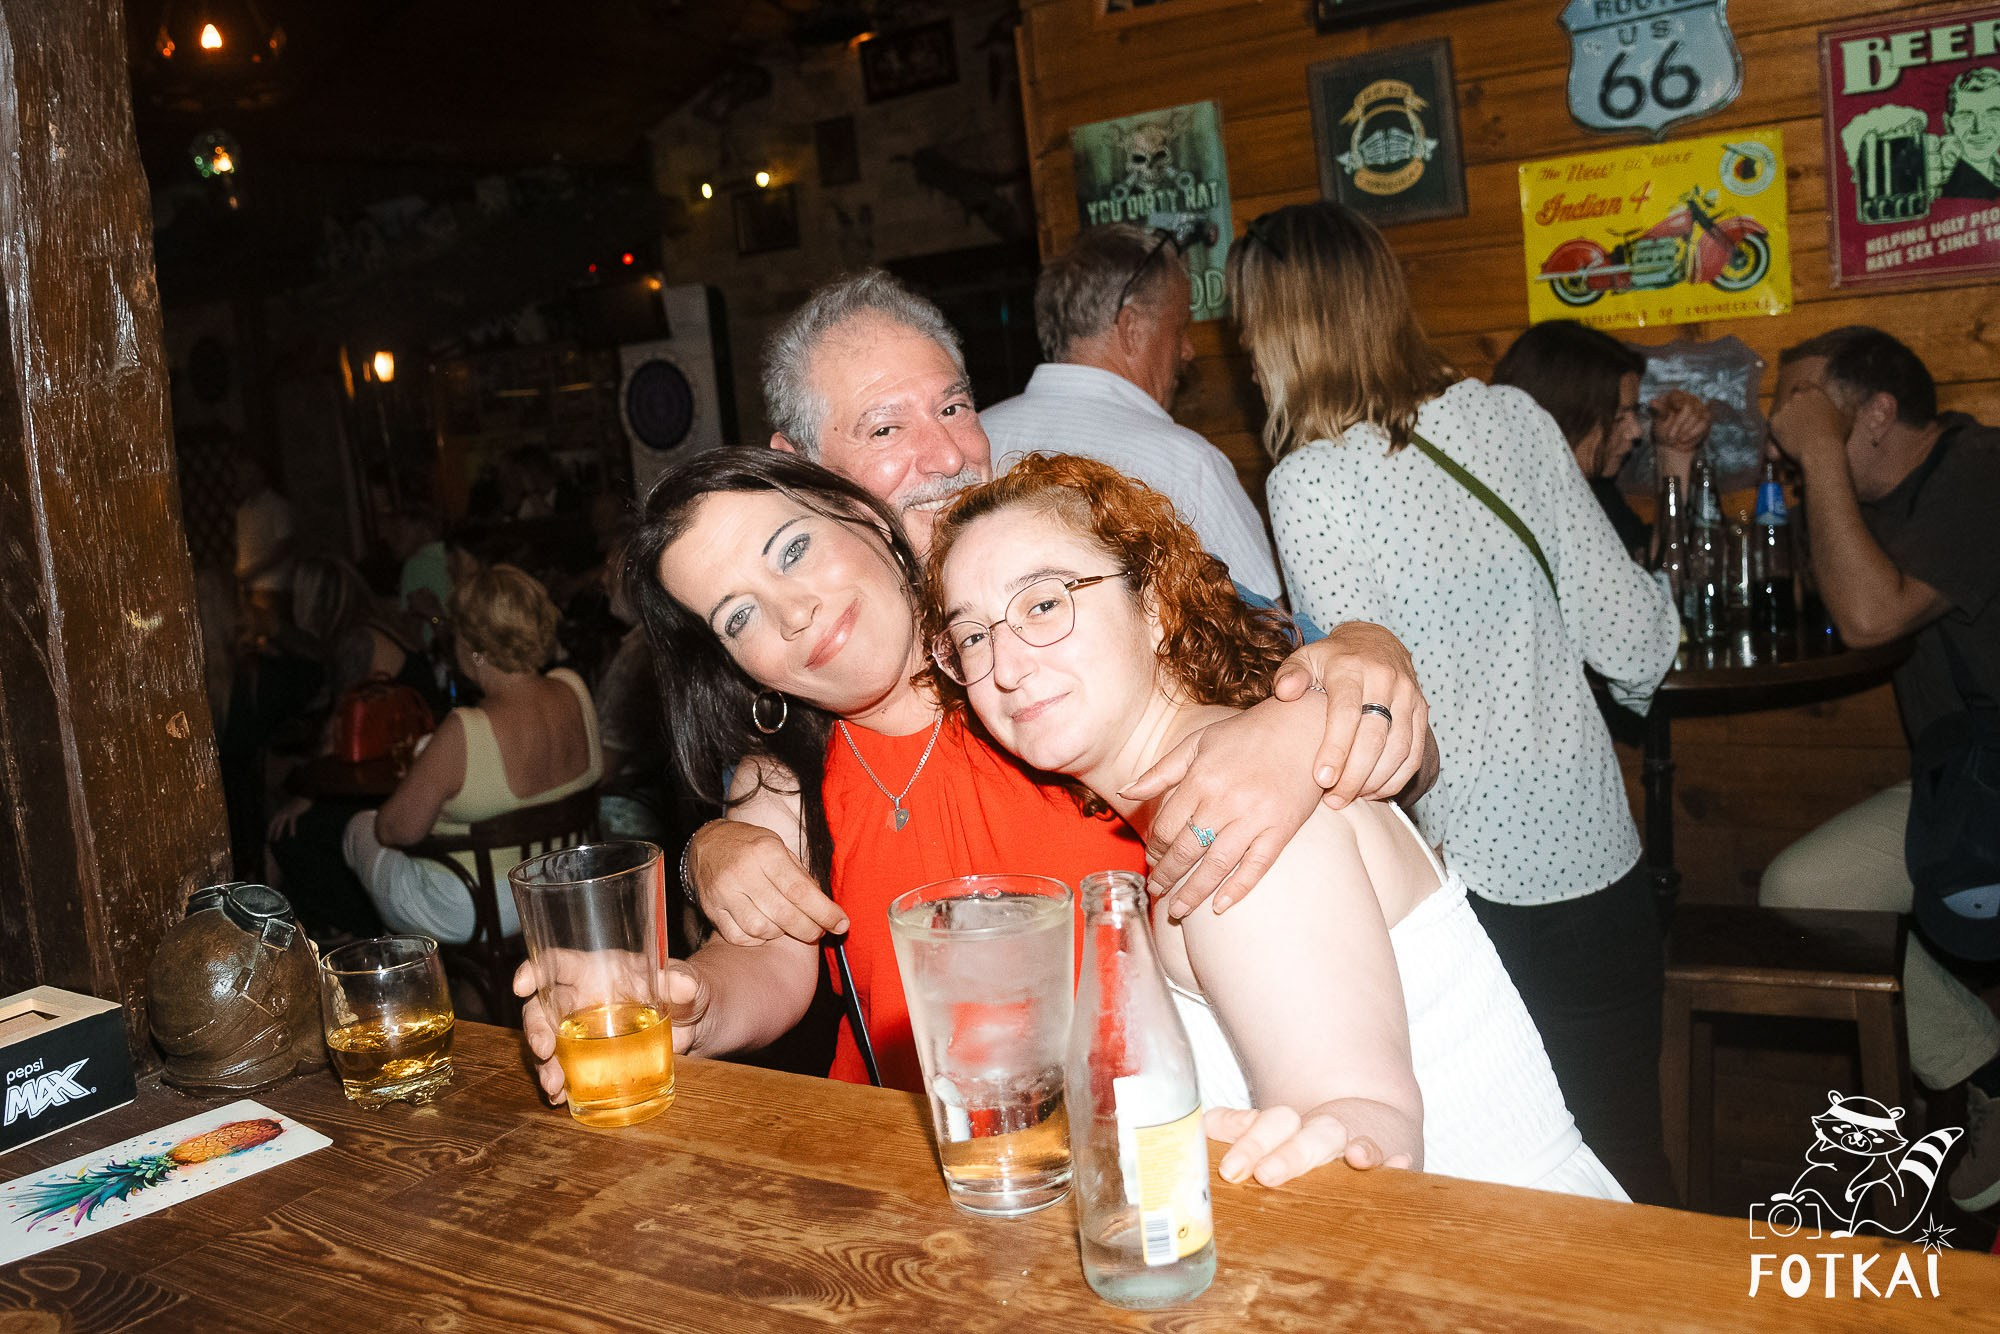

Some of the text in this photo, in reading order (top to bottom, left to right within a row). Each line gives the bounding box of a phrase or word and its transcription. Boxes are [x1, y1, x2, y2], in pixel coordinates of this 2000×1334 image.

[1599, 40, 1701, 120] 66
[1087, 200, 1122, 224] YOU
[1127, 187, 1177, 220] DIRTY
[1536, 180, 1651, 227] Indian 4
[1865, 224, 1927, 255] HELPING
[1930, 215, 1967, 238] UGLY
[1865, 250, 1902, 272] HAVE
[1906, 242, 1934, 263] SEX
[1937, 229, 1979, 254] SINCE
[4, 1058, 92, 1127] MAX
[6, 1057, 44, 1085] pepsi
